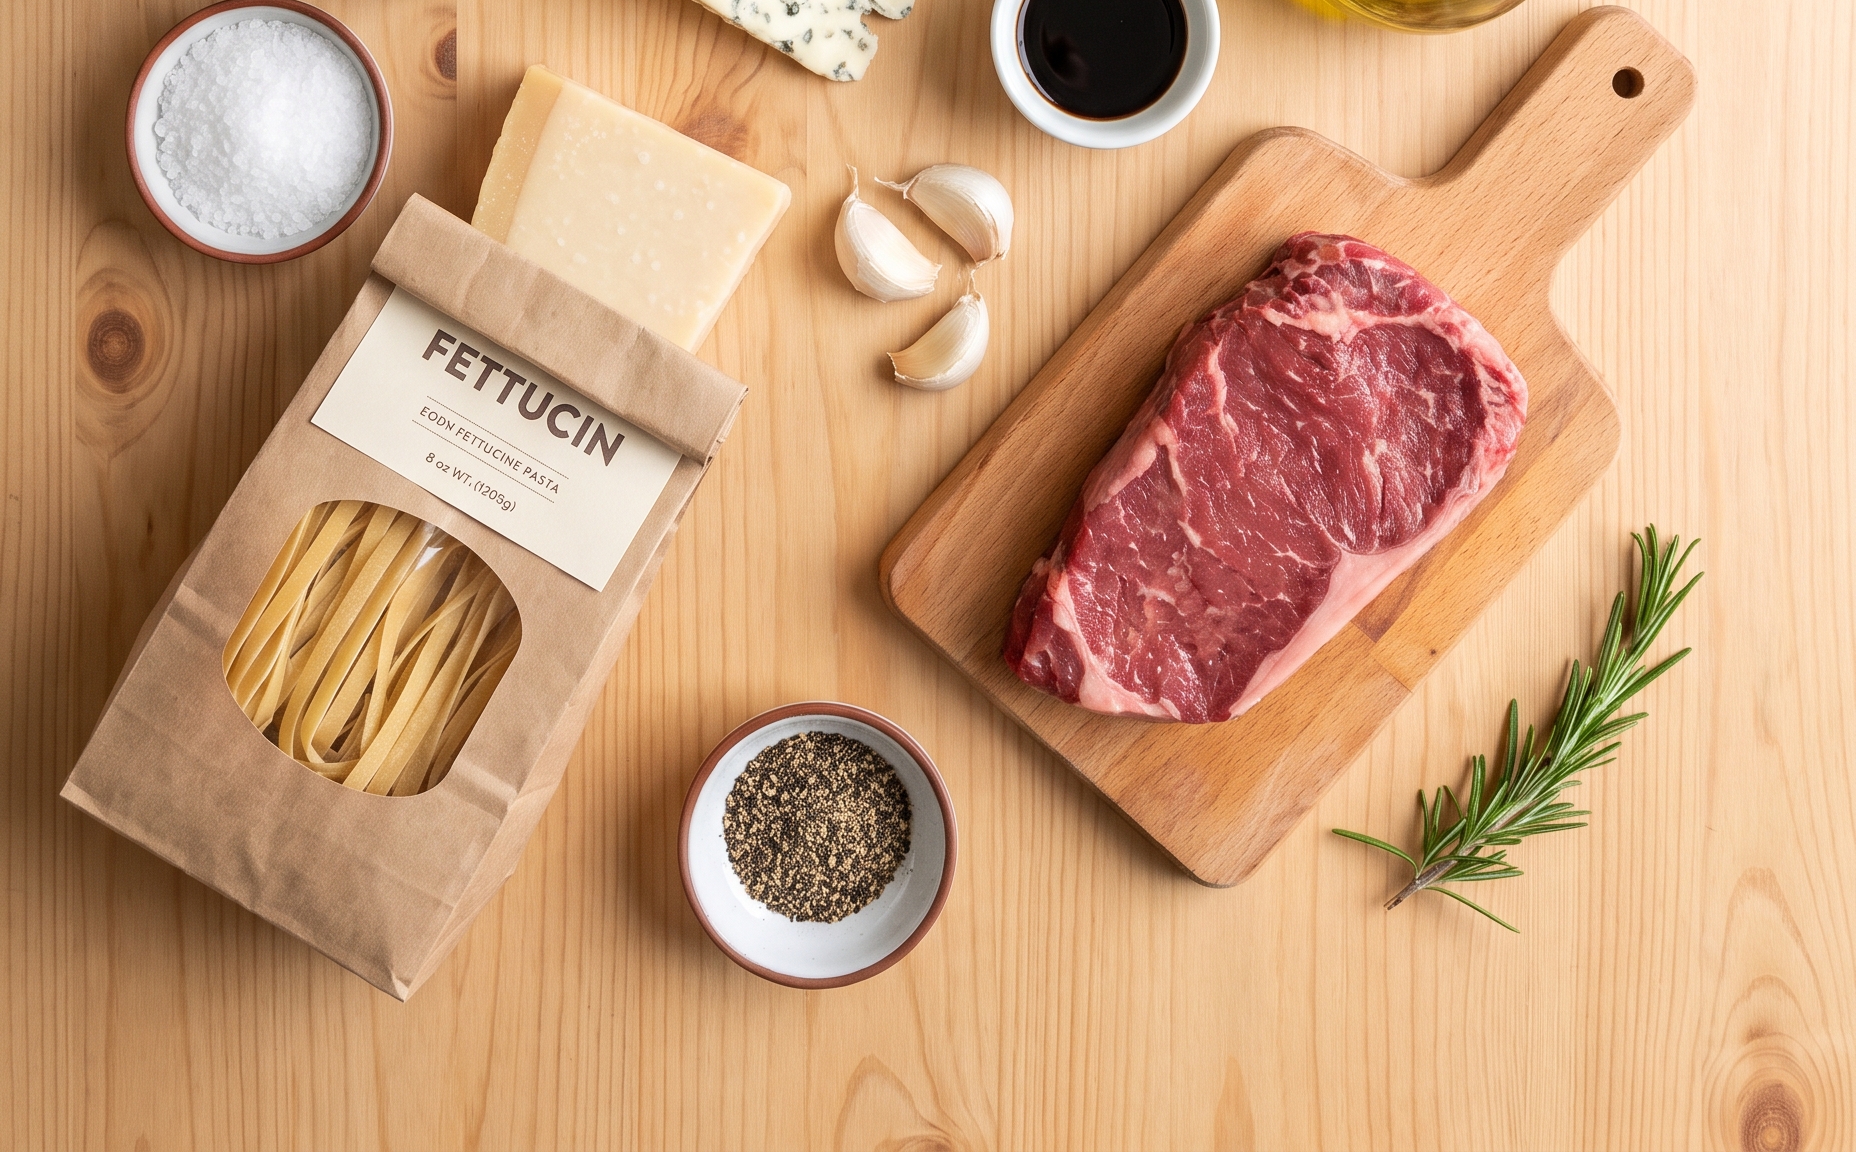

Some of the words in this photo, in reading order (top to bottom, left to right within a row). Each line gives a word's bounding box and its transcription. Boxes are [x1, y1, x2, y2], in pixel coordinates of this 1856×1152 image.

[421, 328, 626, 467] FETTUCIN
[425, 452, 436, 464] 8
[435, 461, 451, 473] oz
[455, 426, 522, 472] FETTUCINE
[522, 466, 559, 494] PASTA
